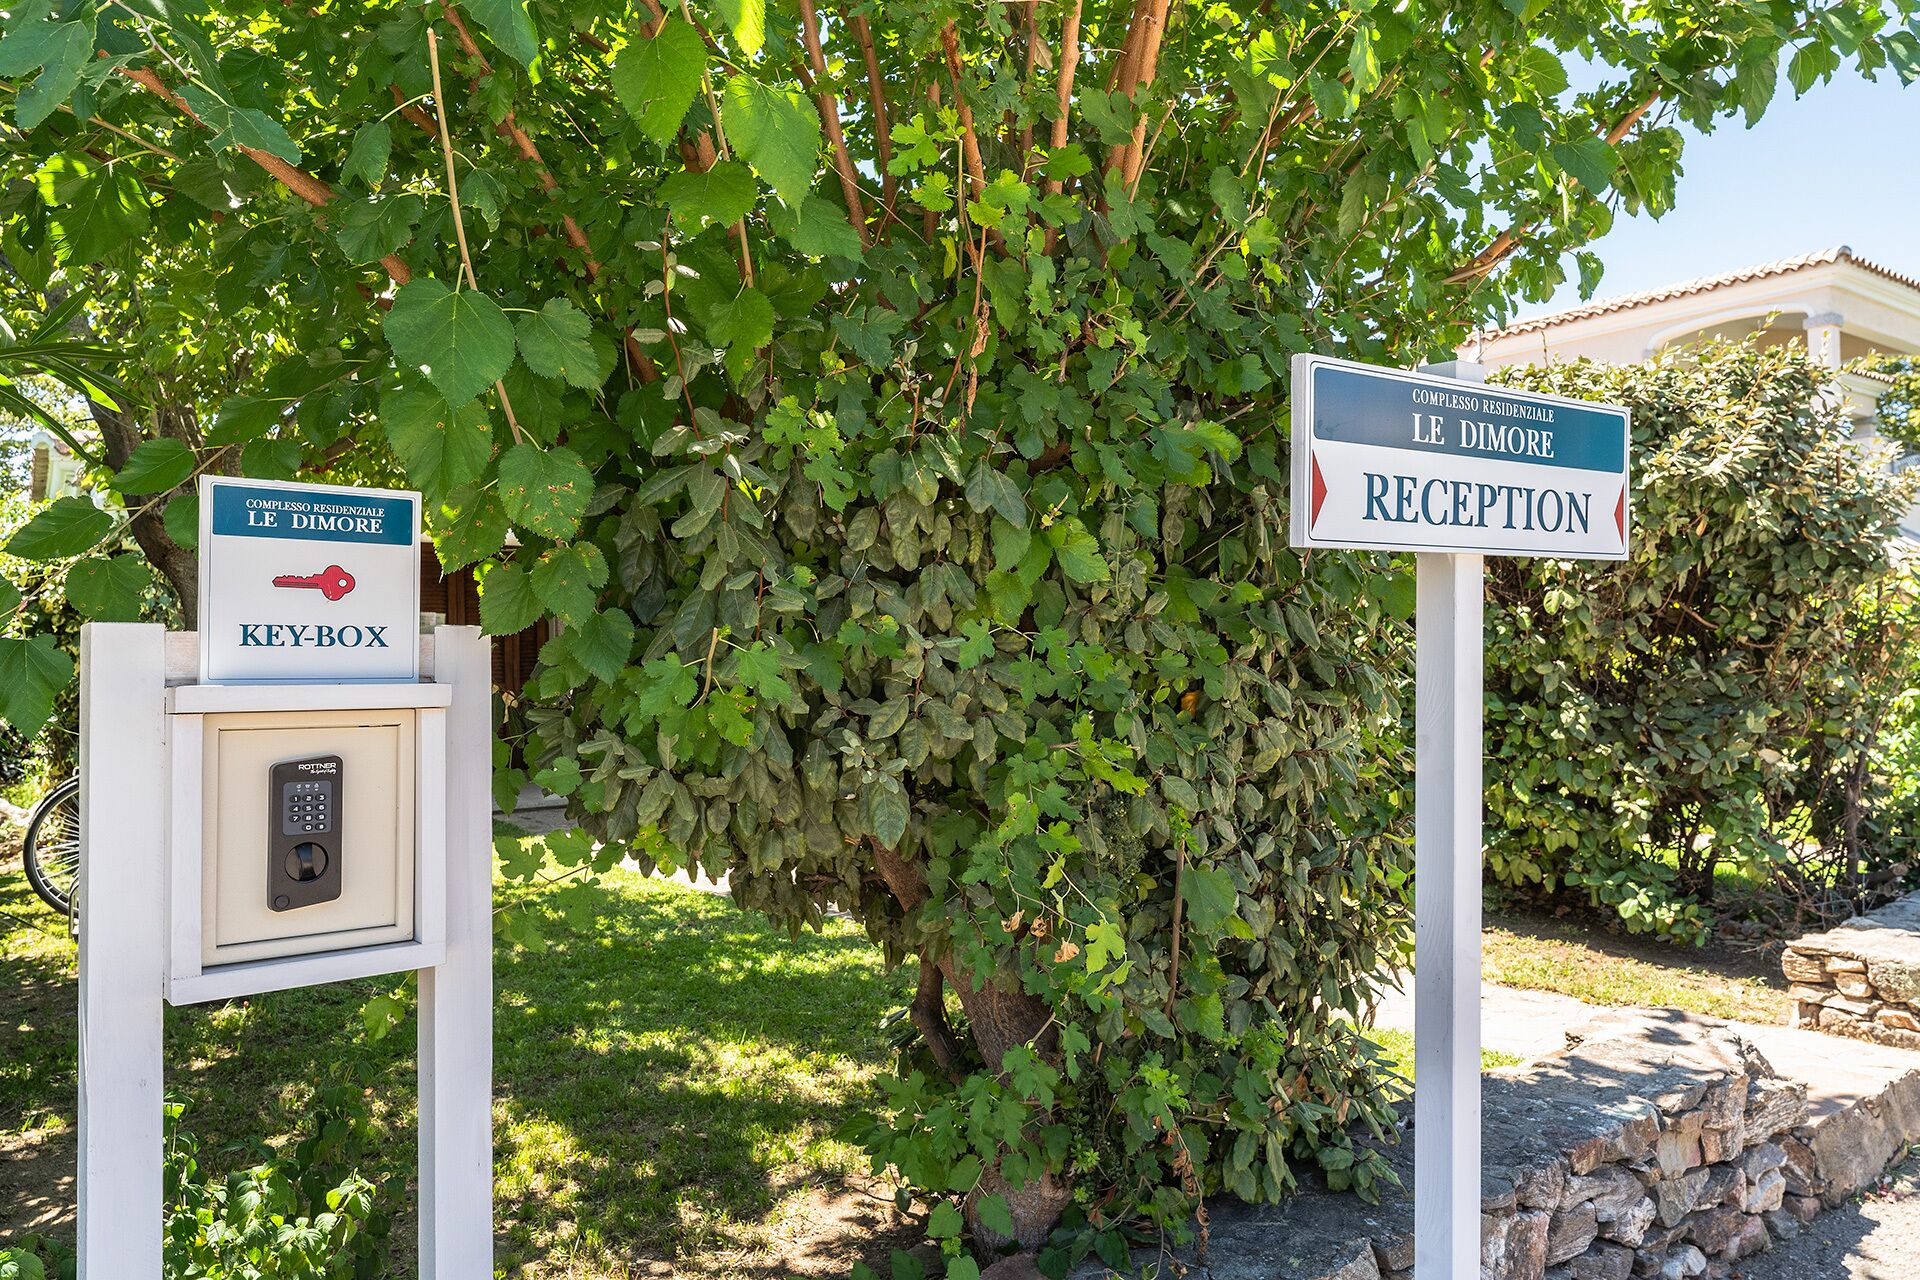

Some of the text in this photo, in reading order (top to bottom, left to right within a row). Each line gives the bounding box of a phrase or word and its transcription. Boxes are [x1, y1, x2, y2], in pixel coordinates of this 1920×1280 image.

[1412, 388, 1555, 423] COMPLESSO RESIDENZIALE
[1411, 412, 1554, 459] LE DIMORE
[246, 499, 385, 517] COMPLESSO RESIDENZIALE
[1362, 472, 1592, 534] RECEPTION
[248, 510, 383, 534] LE DIMORE
[239, 623, 389, 648] KEY-BOX
[298, 763, 337, 771] ROTTNER
